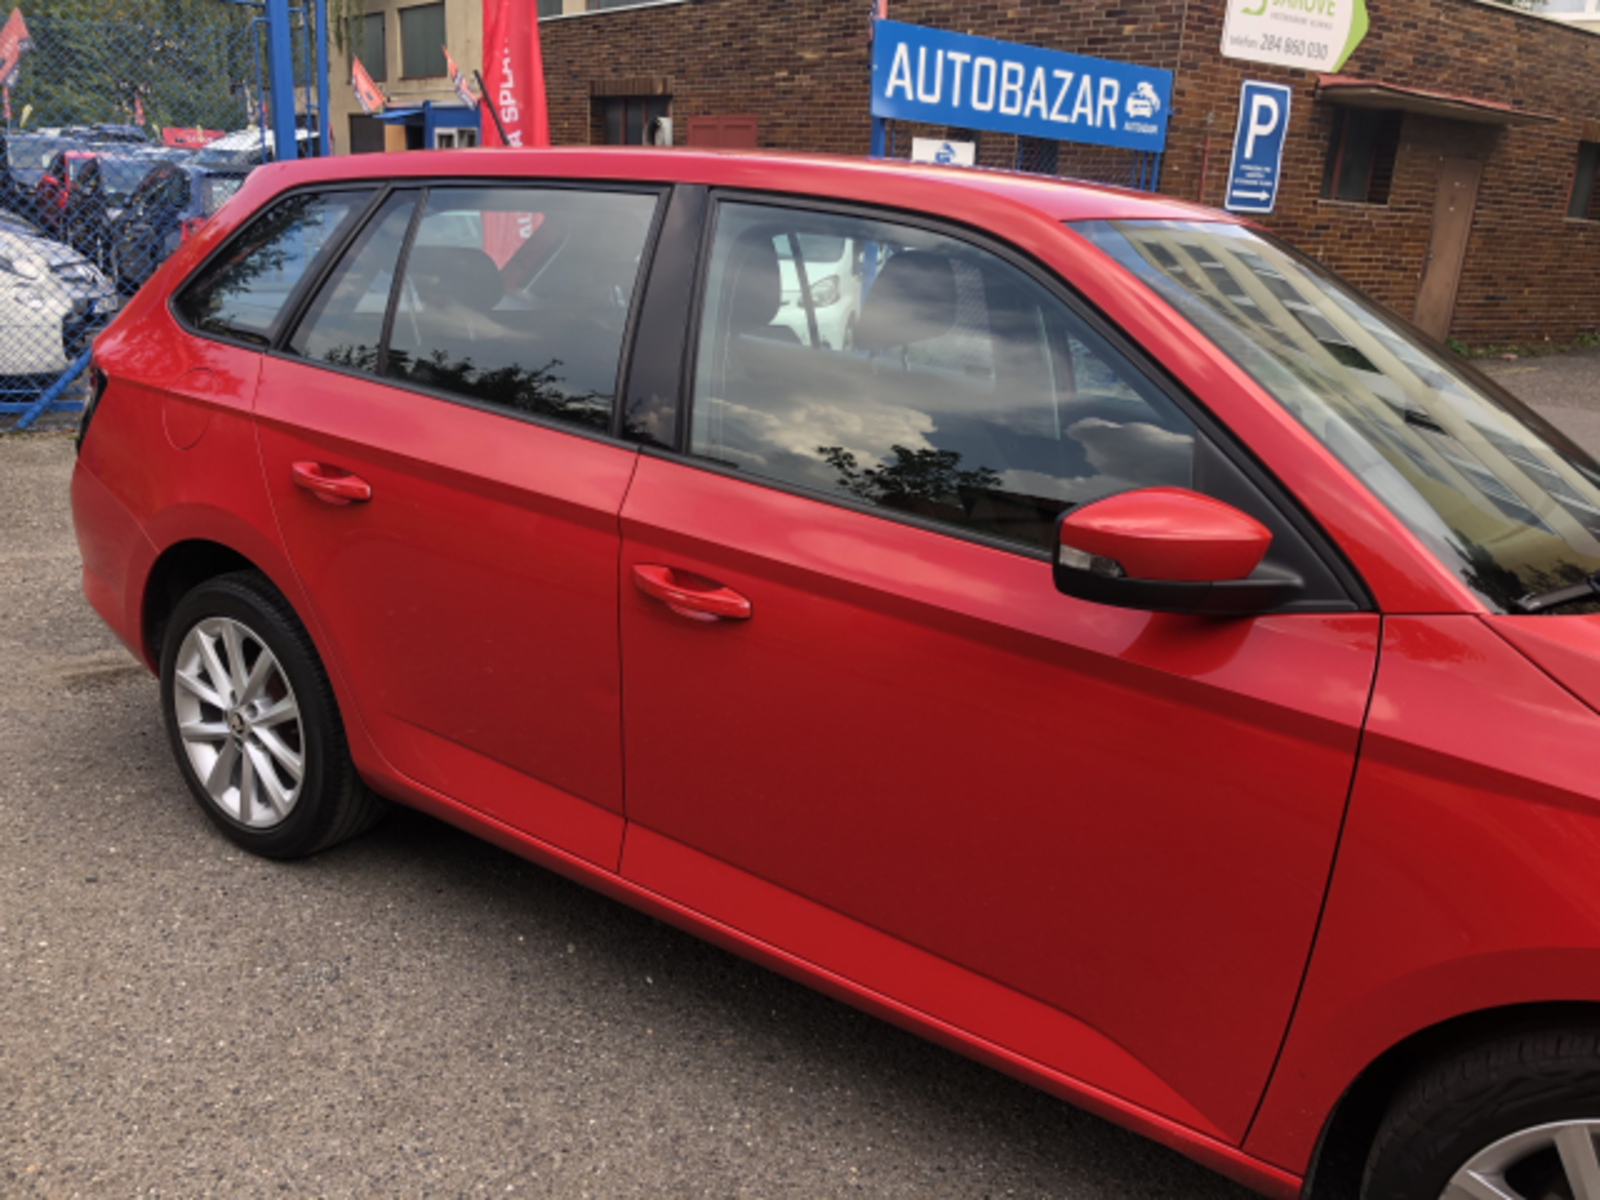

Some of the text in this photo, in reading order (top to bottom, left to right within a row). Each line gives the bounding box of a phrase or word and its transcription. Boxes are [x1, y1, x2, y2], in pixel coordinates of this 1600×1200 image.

[1307, 41, 1328, 60] 030
[884, 42, 1120, 130] AUTOBAZAR
[1244, 94, 1279, 159] P
